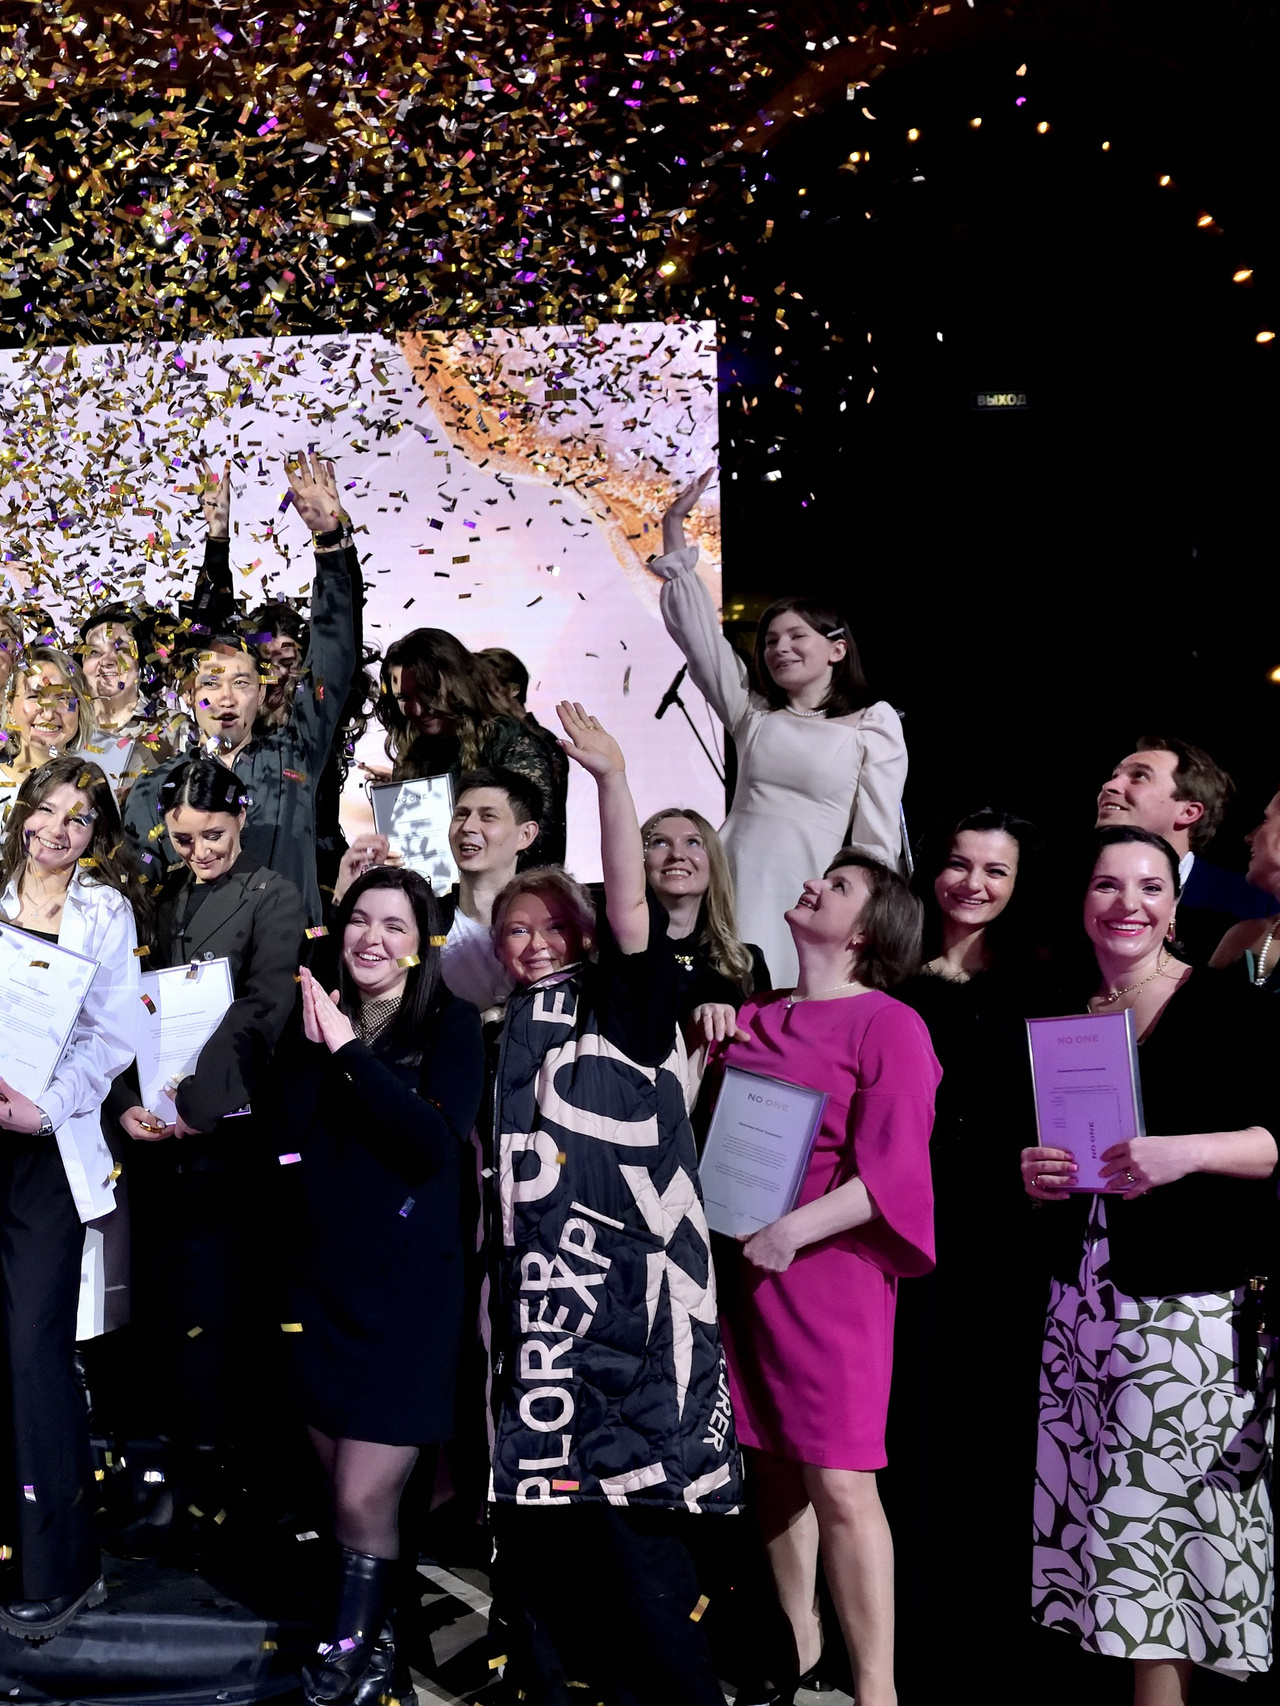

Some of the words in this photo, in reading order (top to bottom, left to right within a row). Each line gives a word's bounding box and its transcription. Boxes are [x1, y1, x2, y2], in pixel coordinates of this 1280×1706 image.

[977, 393, 1027, 406] ВЫХОД
[1057, 1036, 1073, 1045] NO
[1075, 1034, 1100, 1044] ONE
[747, 1092, 763, 1104] NO
[765, 1099, 790, 1113] ONE
[1088, 1120, 1096, 1143] ONE
[1091, 1144, 1097, 1159] NO
